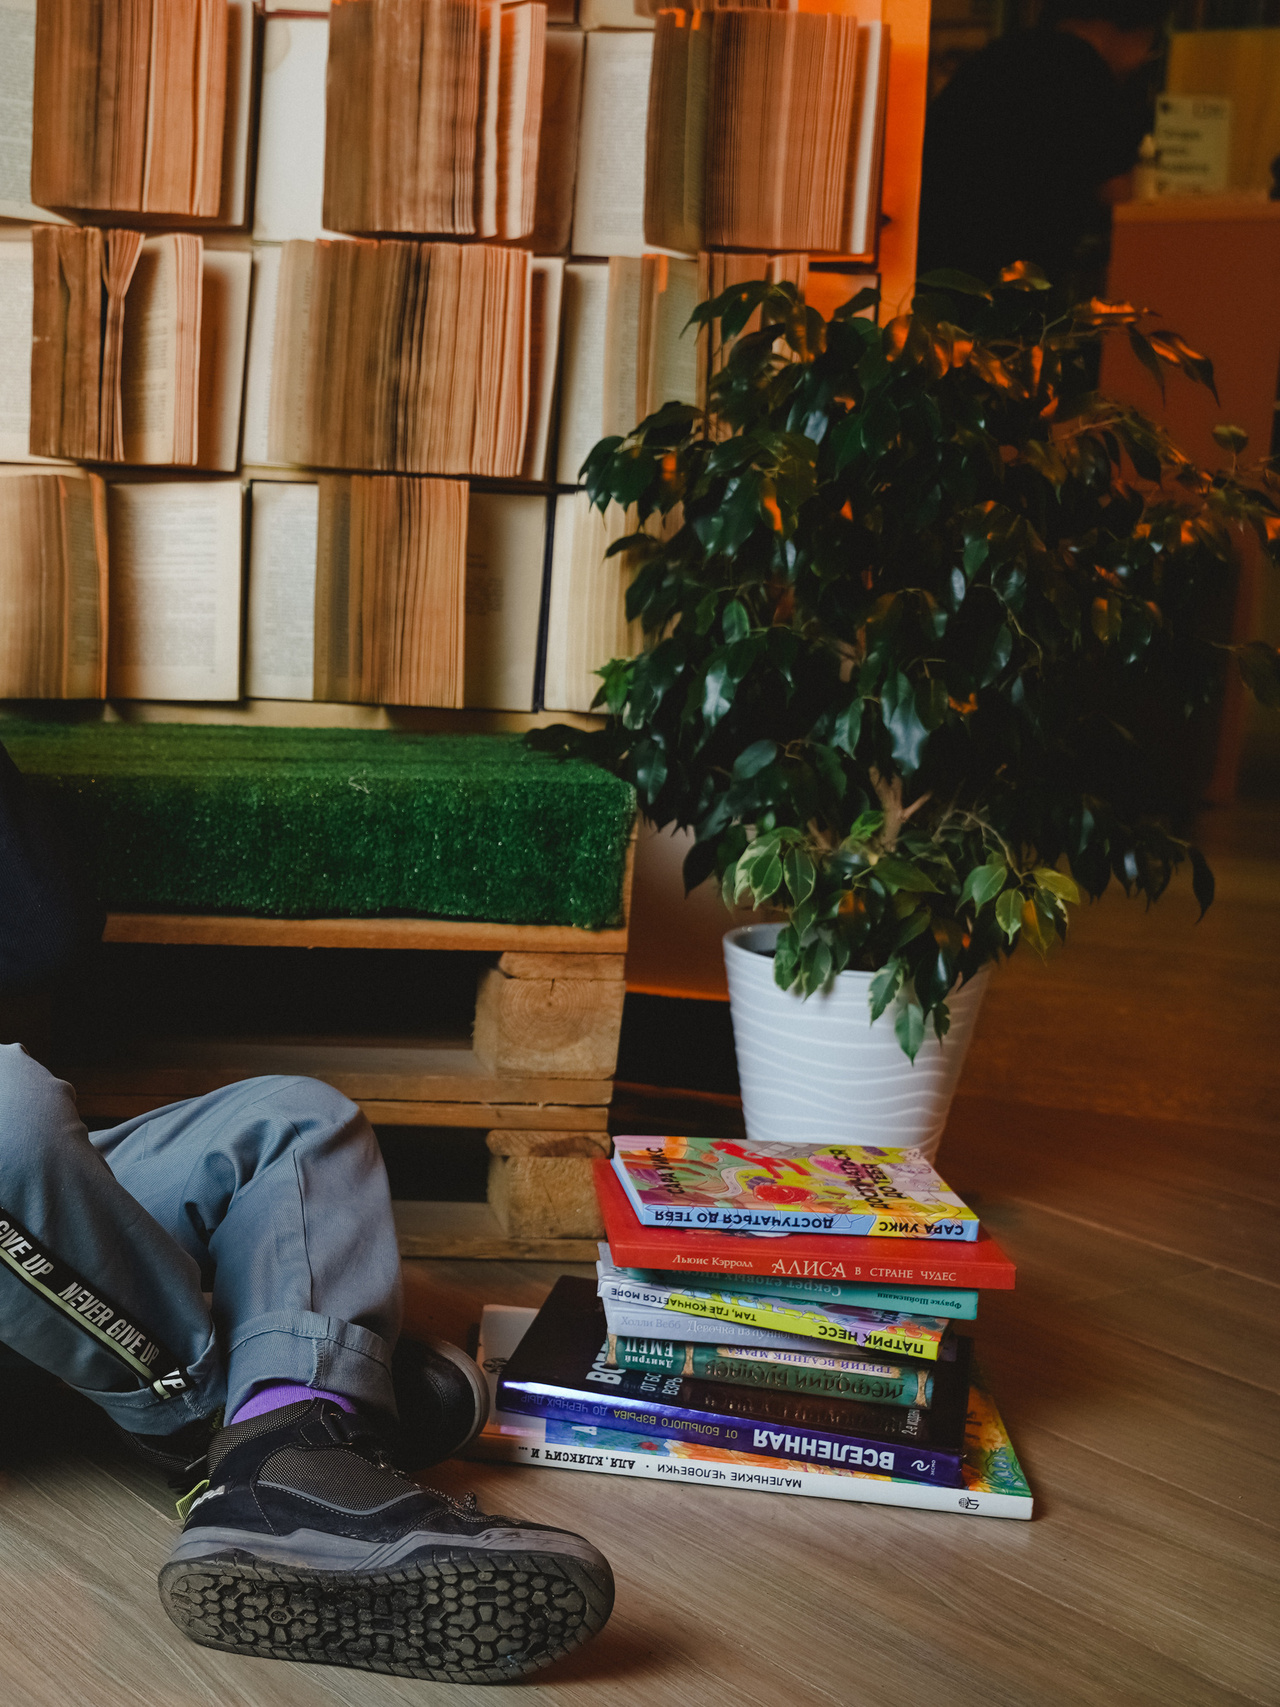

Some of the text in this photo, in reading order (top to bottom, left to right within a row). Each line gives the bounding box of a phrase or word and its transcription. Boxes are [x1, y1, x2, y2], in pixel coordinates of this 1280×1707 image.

[646, 1147, 685, 1195] САРА УИКС
[829, 1149, 894, 1210] ДОСТУЧАТЬСЯ
[860, 1163, 907, 1200] ДО ТЕБЯ
[655, 1210, 834, 1229] ДОСТУЧАТЬСЯ ДО ТЕБЯ
[879, 1221, 964, 1236] САРА УИКС
[21, 1253, 55, 1278] UP
[672, 1255, 753, 1268] Льюис Кэрролл
[771, 1258, 846, 1278] АЛИСА
[870, 1267, 913, 1279] СТРАНЕ
[920, 1270, 957, 1282] ЧУДЕС
[786, 1279, 842, 1297] Секрет
[611, 1288, 757, 1321] ТАМ, ГДЕ КОНЧАЕТСЯ МОРЕ
[930, 1299, 962, 1309] Фрауке
[58, 1281, 160, 1367] NEVER GIVE UP
[621, 1316, 681, 1329] Холли Вебб
[687, 1320, 735, 1335] Девочка
[737, 1325, 750, 1336] из
[818, 1325, 858, 1342] НЕСС
[864, 1333, 924, 1354] ПАТРИК
[625, 1354, 673, 1369] Дмитрий
[728, 1346, 892, 1375] ТРЕТИЙ ВСАДНИК МРАКА
[547, 1398, 589, 1413] ЧЕРНЫХ
[593, 1405, 608, 1416] ДО
[614, 1409, 657, 1425] ВЗРЫВА
[661, 1417, 720, 1436] БОЛЬШОГО
[725, 1429, 738, 1439] ОТ
[530, 1447, 540, 1458] И
[545, 1449, 604, 1466] КЛЯКСИЧ
[753, 1428, 895, 1470] ВСЕЛЕННАЯ
[657, 1463, 802, 1488] МАЛЕНЬКИЕ ЧЕЛОВЕЧКИ
